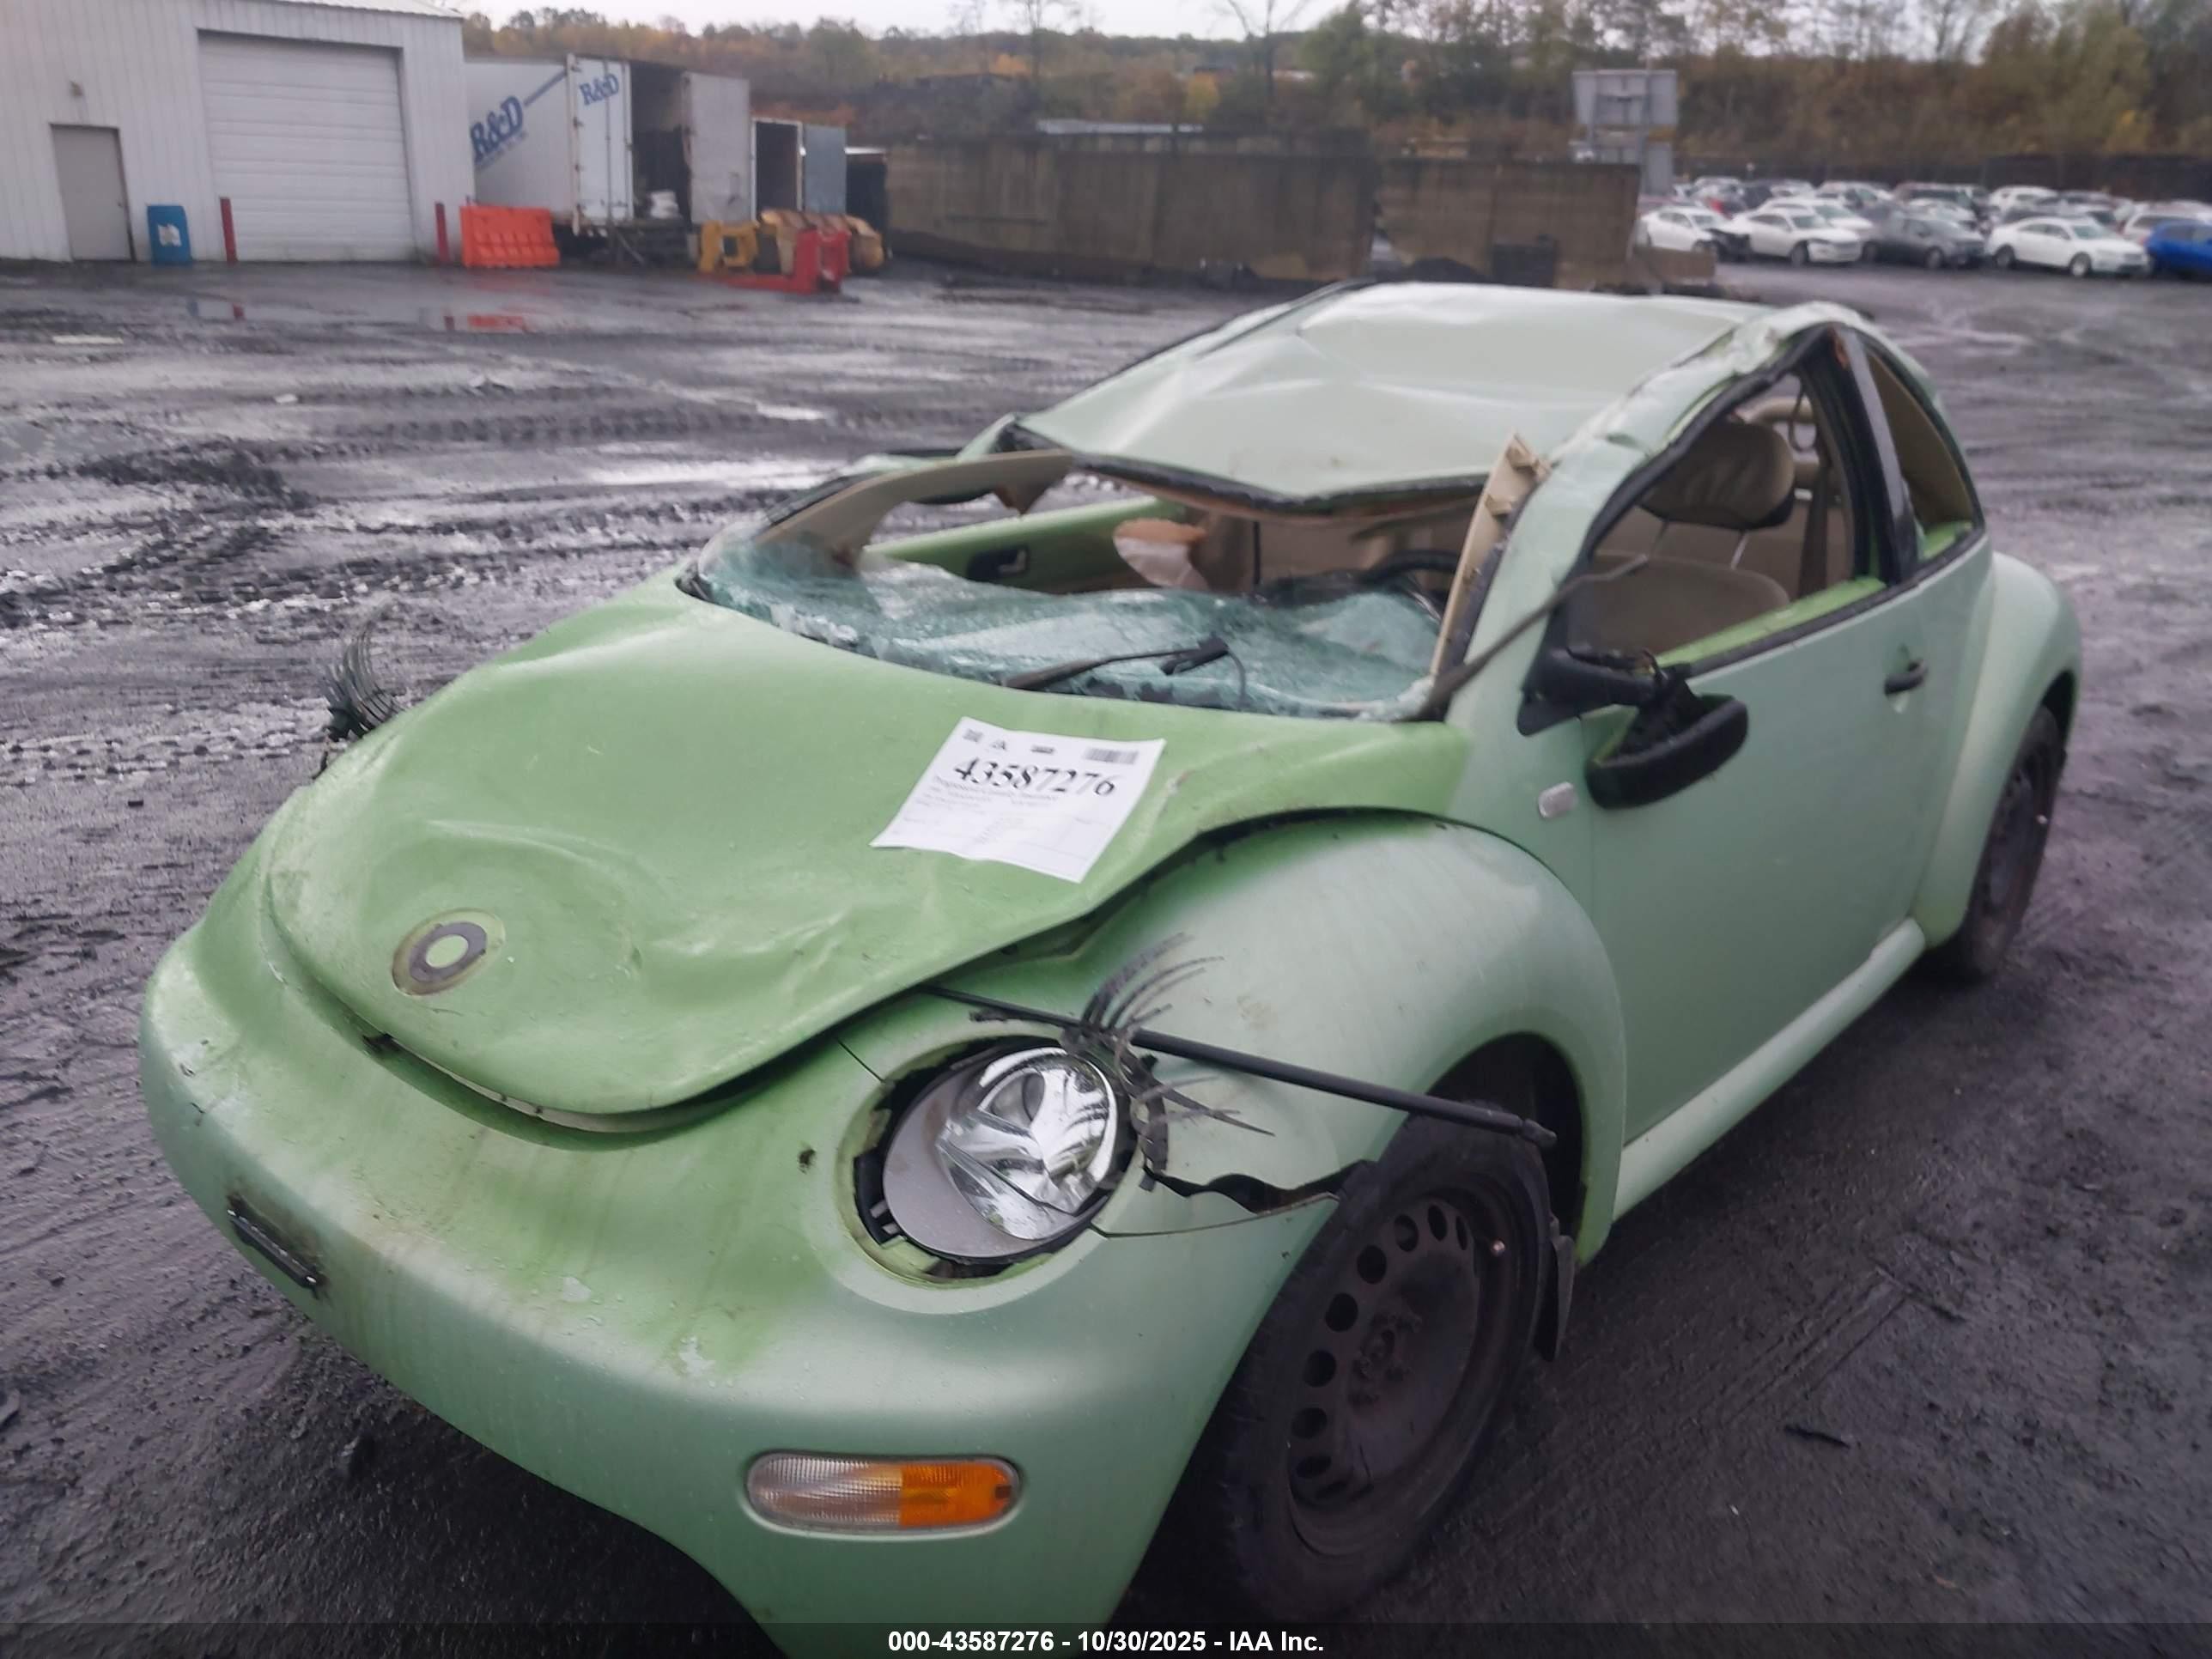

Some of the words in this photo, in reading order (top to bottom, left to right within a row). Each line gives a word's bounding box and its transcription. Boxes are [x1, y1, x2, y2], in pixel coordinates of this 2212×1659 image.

[579, 72, 620, 106] R&D
[471, 94, 524, 164] R&D
[953, 757, 1121, 797] 43587276
